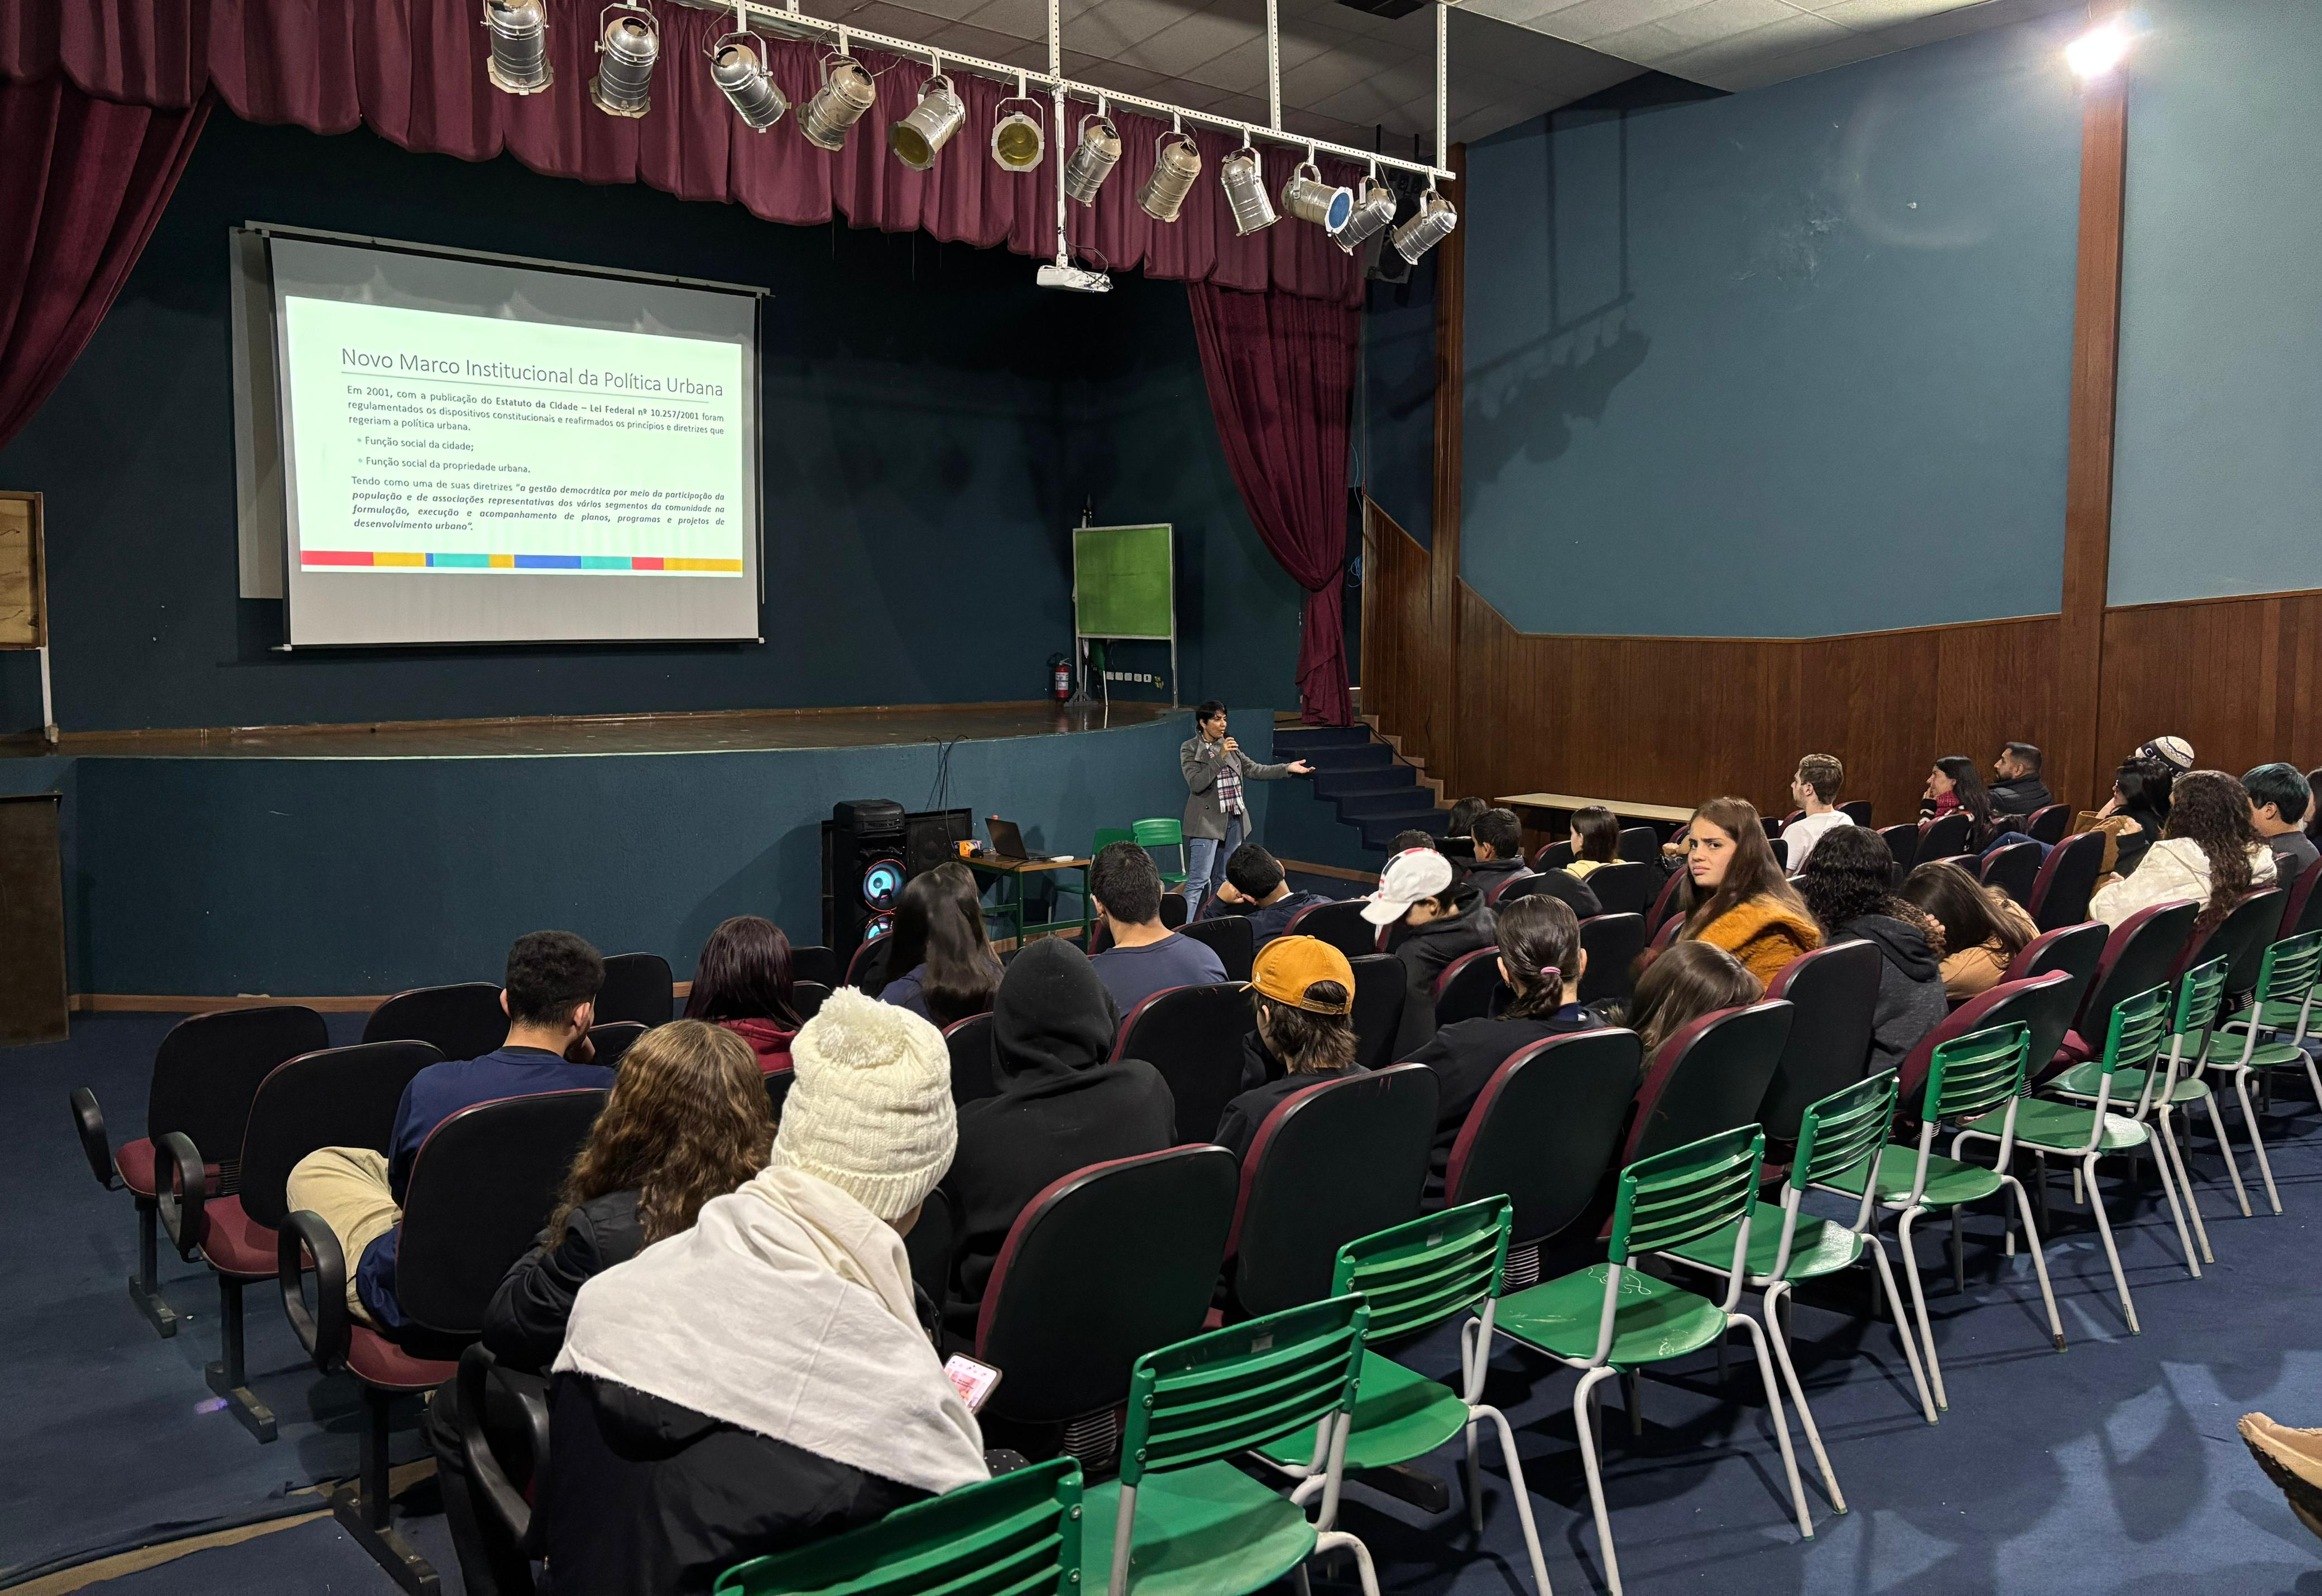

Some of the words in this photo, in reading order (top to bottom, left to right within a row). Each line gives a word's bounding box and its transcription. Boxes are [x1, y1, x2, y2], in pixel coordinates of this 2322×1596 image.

[342, 348, 393, 368] Novo
[400, 353, 459, 374] Marco
[467, 359, 572, 384] Institucional
[579, 369, 598, 386] da
[605, 372, 661, 391] Política
[667, 377, 722, 396] Urbana
[347, 385, 362, 395] Em
[367, 387, 392, 398] 2001,
[430, 393, 477, 405] publicação
[481, 396, 492, 405] do
[496, 397, 532, 407] Estatuto
[535, 400, 546, 408] da
[590, 404, 602, 412] Lei
[605, 405, 635, 415] Federal
[651, 409, 699, 420] 10.257/2001
[702, 412, 724, 422] foram
[348, 401, 423, 414] regulamentados
[439, 407, 490, 418] dispositivos
[493, 412, 555, 422] constitucionais
[565, 416, 613, 426] reafirmados
[627, 421, 664, 431] princípios
[674, 424, 708, 433] diretrizes
[349, 416, 391, 425] regeriam
[402, 419, 434, 429] política
[437, 421, 471, 431] urbana.
[365, 436, 399, 448] Função
[401, 439, 426, 448] social
[429, 440, 439, 449] da
[442, 441, 473, 452] cidade;
[366, 456, 399, 468] Função
[402, 459, 426, 468] social
[429, 460, 440, 468] da
[443, 462, 496, 471] propriedade
[498, 464, 530, 473] urbana.
[351, 476, 380, 485] Tendo
[436, 480, 447, 488] de
[473, 482, 512, 491] diretrizes
[560, 485, 611, 495] democrática
[665, 491, 712, 501] participação
[352, 491, 402, 502] população
[416, 493, 428, 501] de
[433, 495, 484, 504] associações
[488, 498, 554, 506] representativas
[558, 498, 573, 507] dos
[577, 499, 601, 508] vários
[352, 504, 409, 516] formulação,
[418, 508, 459, 518] execução
[479, 511, 557, 520] acompanhamento
[564, 512, 574, 520] de
[581, 512, 611, 522] planos,
[678, 517, 709, 526] projetos
[354, 518, 433, 529] desenvolvimento
